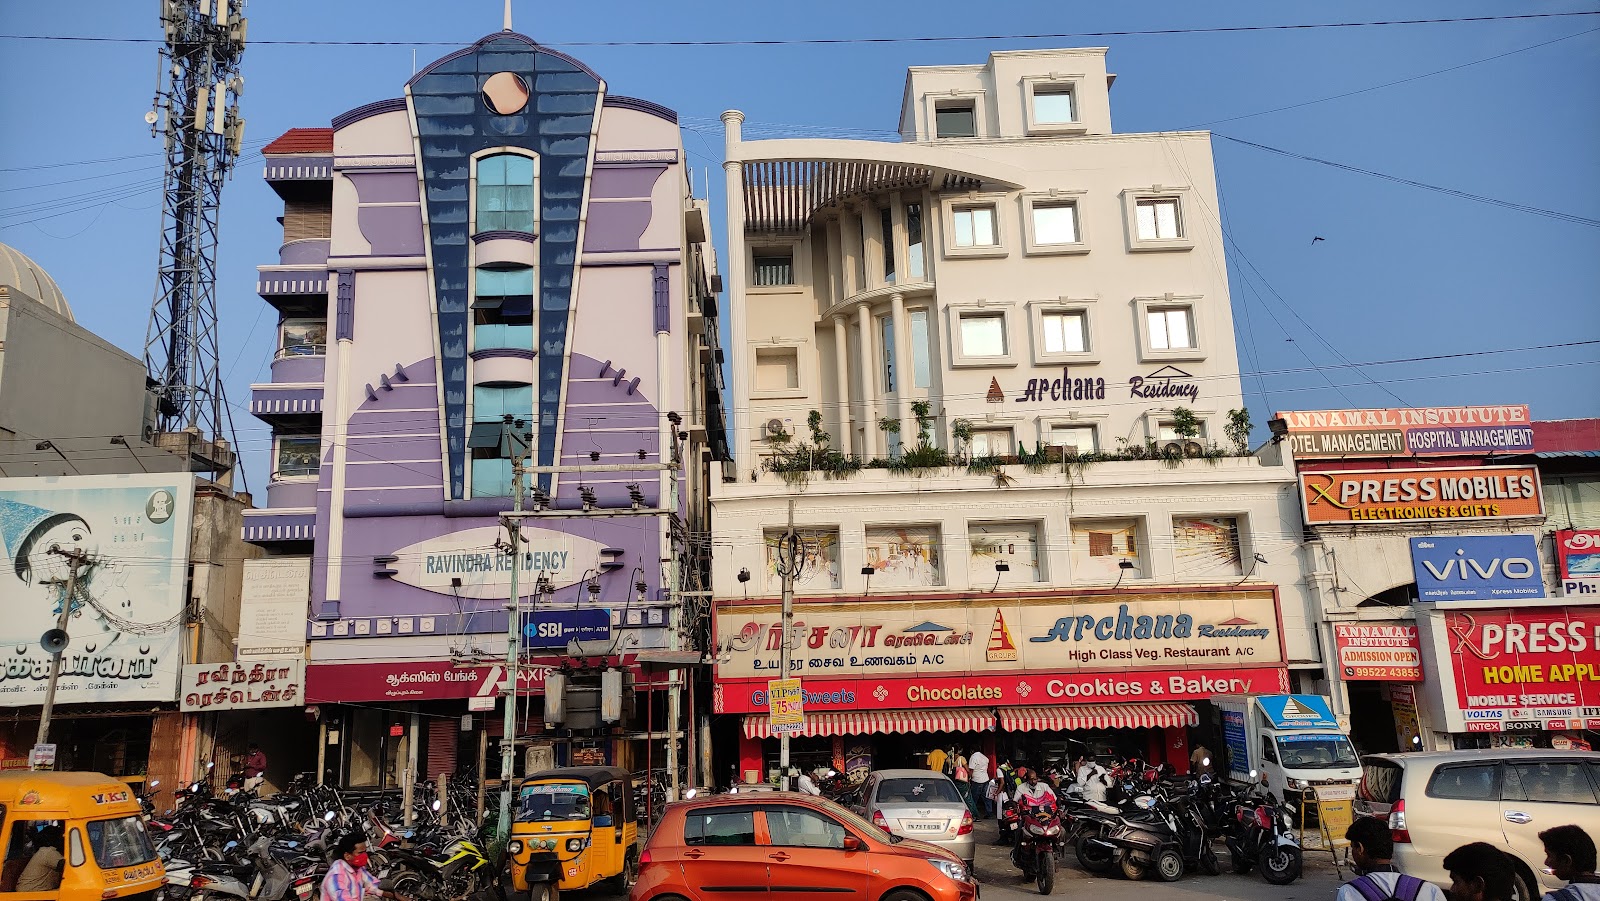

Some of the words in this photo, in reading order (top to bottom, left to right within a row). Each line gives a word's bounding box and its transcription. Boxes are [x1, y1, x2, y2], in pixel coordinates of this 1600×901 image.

[1015, 367, 1105, 402] Archana
[1129, 376, 1199, 403] Residency
[1282, 411, 1396, 428] ANNAMAL
[1400, 406, 1526, 425] INSTITUTE
[1284, 434, 1320, 453] OTEL
[1321, 432, 1402, 452] MANAGEMENT
[1408, 430, 1460, 449] HOSPITAL
[1460, 428, 1533, 447] MANAGEMENT
[1440, 475, 1536, 502] MOBILES
[1351, 504, 1447, 520] ELECTRONICS
[1449, 504, 1459, 517] &
[1461, 503, 1501, 517] GIFTS
[426, 553, 492, 574] RAVINDRA
[495, 550, 568, 572] REIDENCY
[1422, 548, 1535, 581] vivo
[1491, 588, 1513, 596] Xpress
[1513, 587, 1538, 595] Mobiles
[1565, 581, 1597, 595] Ph:
[538, 622, 563, 638] SBI
[1197, 624, 1270, 640] Residency
[1339, 626, 1416, 638] ANNAMAL
[1347, 637, 1410, 647] INSTITUTE
[808, 658, 845, 668] சைவ
[850, 652, 917, 667] உணவகம்
[922, 654, 945, 665] A/C
[988, 652, 1017, 660] GROUPS
[1069, 651, 1097, 662] High
[1099, 649, 1133, 660] Class
[1134, 648, 1162, 662] Veg.
[1164, 646, 1231, 658] Restaurant
[1235, 647, 1254, 656] A/C
[1344, 651, 1393, 662] ADMISSION
[1394, 651, 1418, 662] OPEN
[195, 664, 291, 687] ரவீந்திரா
[386, 671, 441, 687] ஆக்ஸிஸ்
[444, 670, 478, 682] பேங்க்
[516, 669, 553, 681] AXIS
[1356, 668, 1387, 677] 99522
[1389, 668, 1420, 678] 43855
[1483, 665, 1545, 684] HOME
[907, 684, 1003, 702] Chocolates
[1046, 679, 1143, 698] Cookies
[1149, 681, 1164, 695] &
[1168, 676, 1252, 695] Bakery
[185, 684, 299, 709] ரெசிடென்சி
[801, 687, 855, 704] Sweets
[1467, 694, 1518, 707] MOBILE
[1519, 693, 1577, 705] SERVICE
[776, 700, 788, 714] 75
[1467, 710, 1503, 719] VOLTAS
[1537, 708, 1572, 717] SAMSUNG
[1506, 721, 1541, 730] SONY
